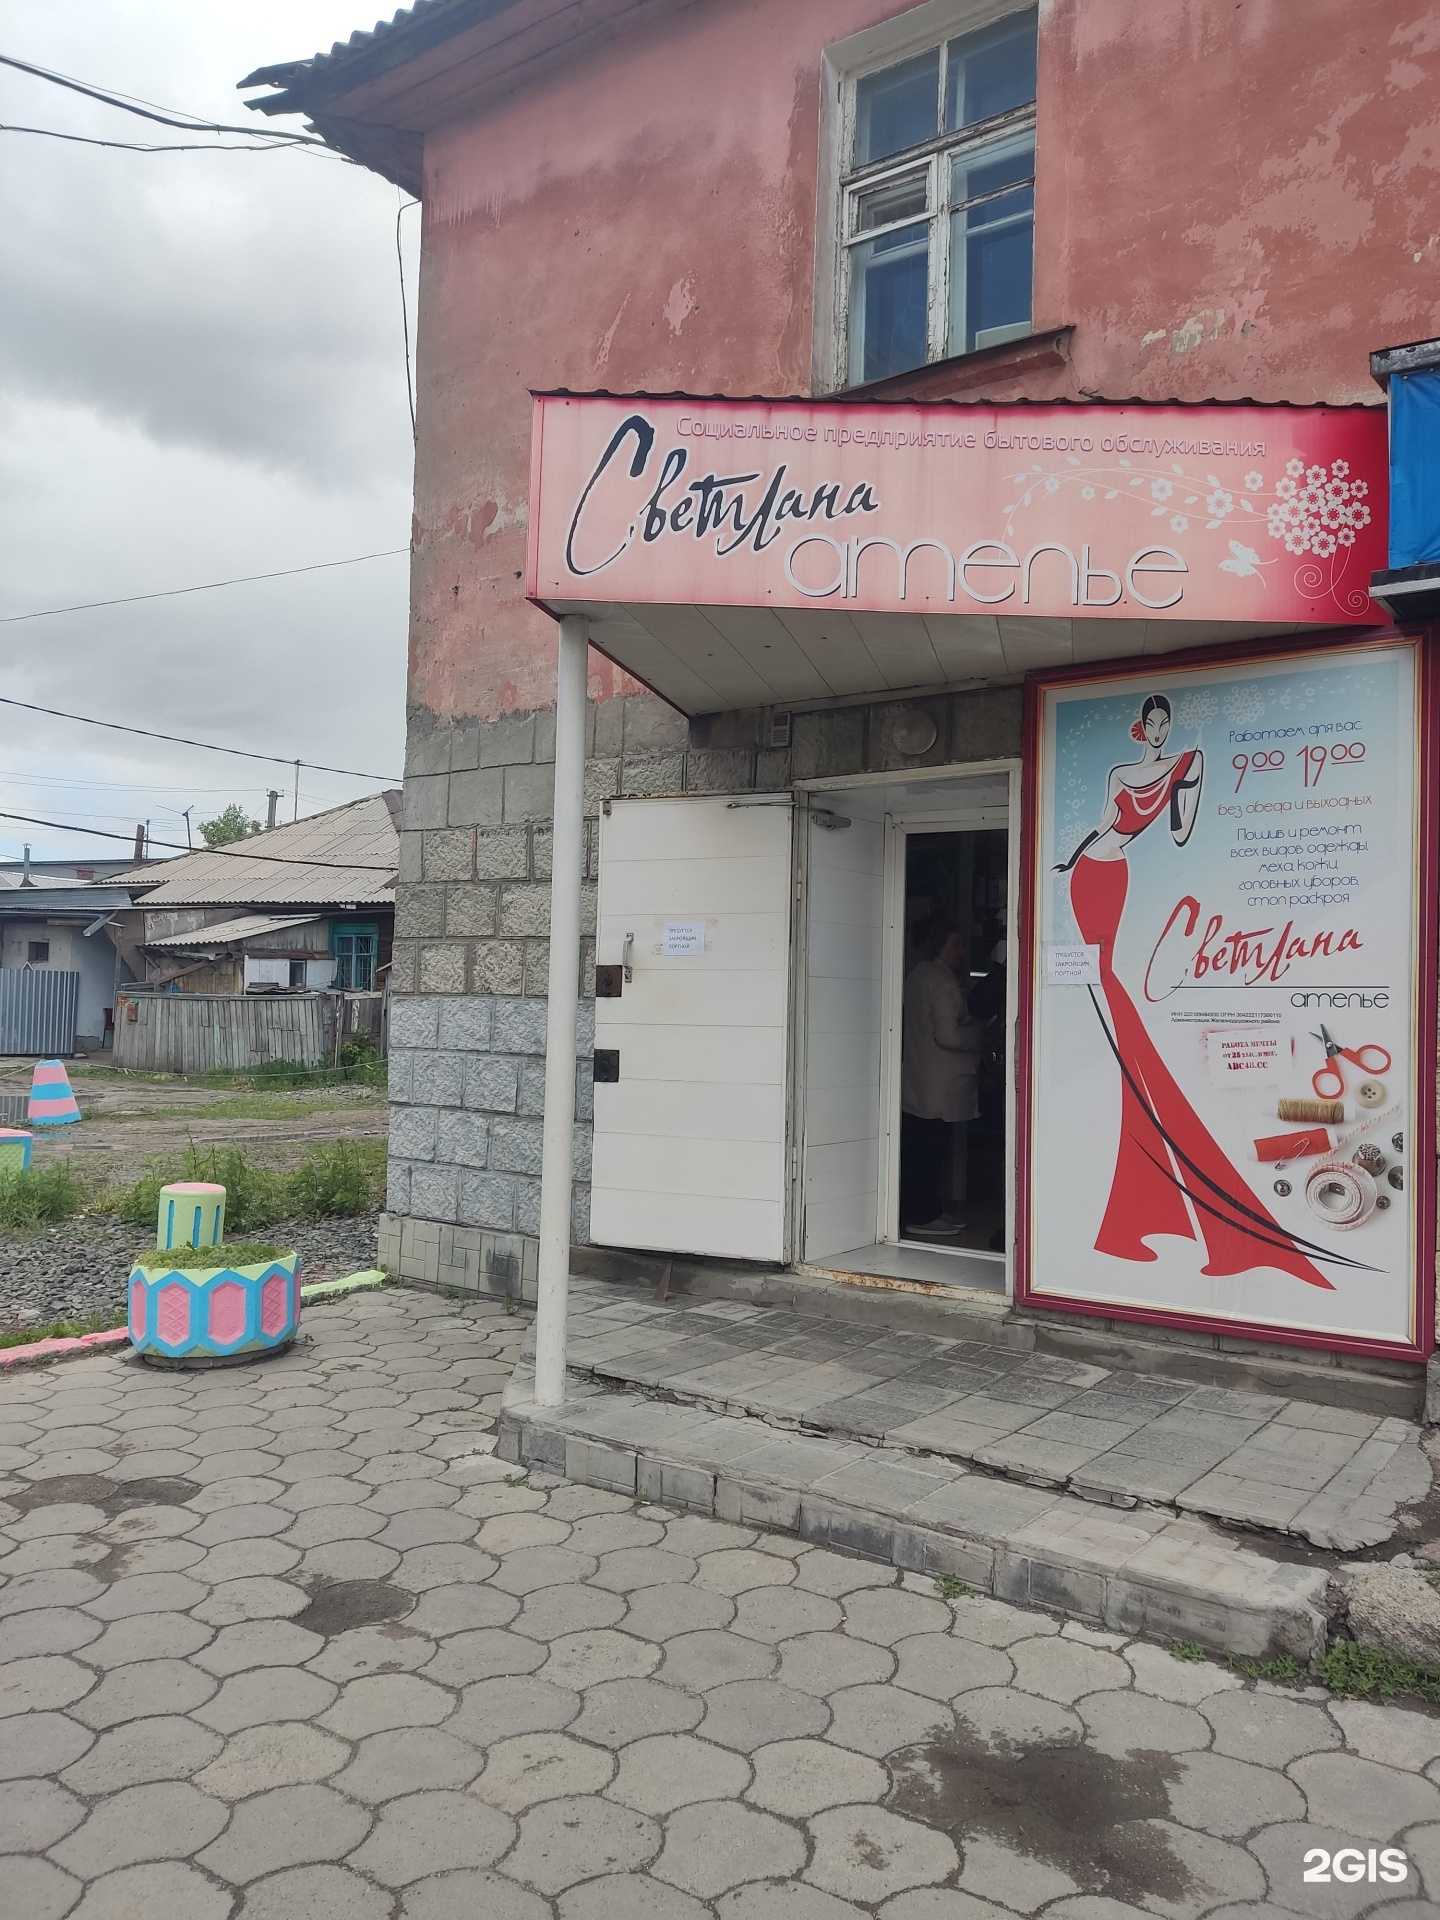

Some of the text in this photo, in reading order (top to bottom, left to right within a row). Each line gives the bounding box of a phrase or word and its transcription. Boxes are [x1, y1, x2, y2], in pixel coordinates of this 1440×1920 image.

[676, 416, 1266, 459] Социальное предприятие бытового обслуживания
[565, 414, 879, 576] Светлана
[784, 533, 1189, 609] ателье
[1229, 726, 1305, 744] Работаем
[1335, 719, 1363, 733] вас
[1246, 801, 1292, 815] обеда
[1306, 795, 1373, 811] выходных
[1237, 824, 1362, 841] Пошив и ремонт
[1230, 840, 1369, 860] всех видов одежды
[1258, 857, 1339, 873] меха кожи
[1238, 878, 1300, 890] головных
[1248, 891, 1350, 908] стол раскроя
[1144, 895, 1364, 1003] Светлана
[1290, 991, 1390, 1009] ателье
